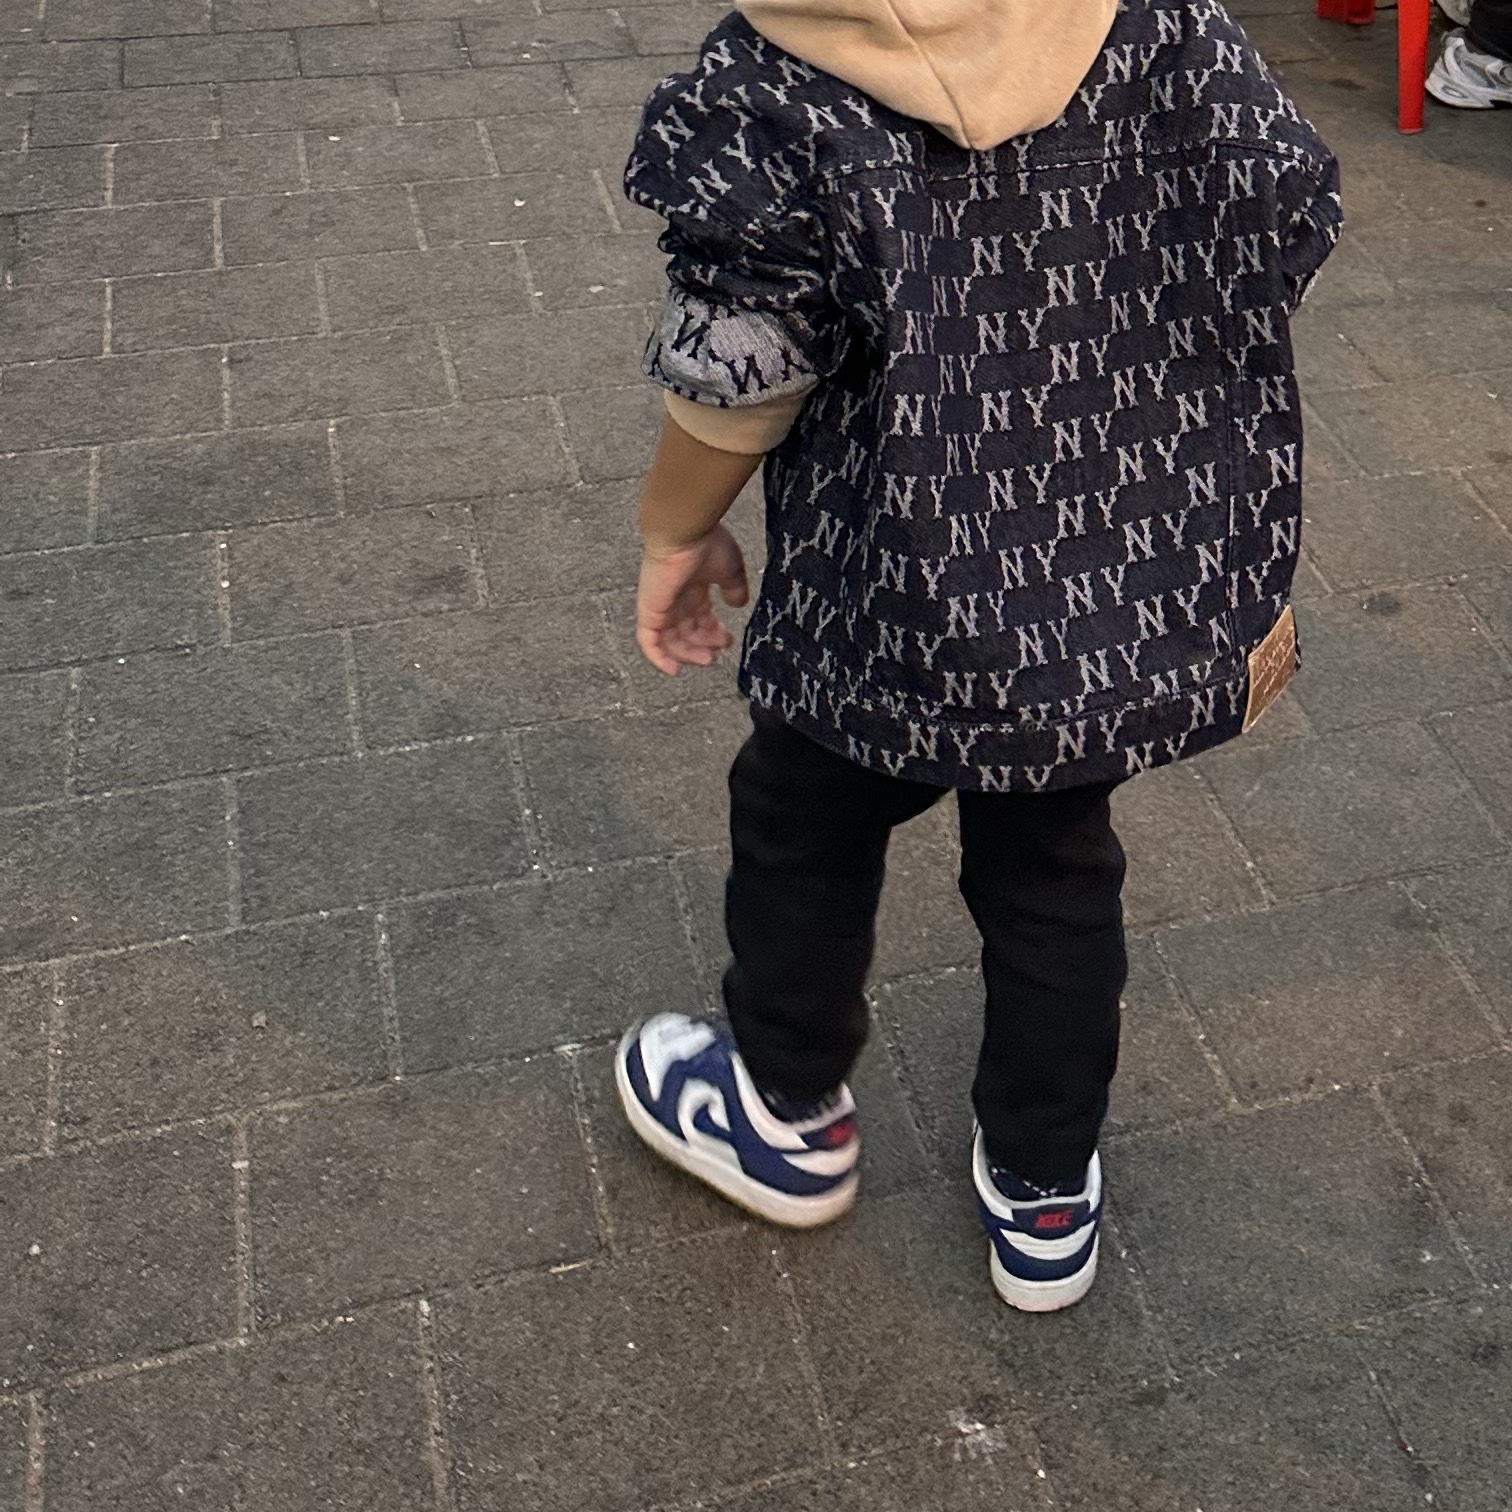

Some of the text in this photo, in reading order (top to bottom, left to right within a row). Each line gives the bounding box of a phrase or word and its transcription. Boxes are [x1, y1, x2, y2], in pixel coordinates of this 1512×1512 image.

[1155, 4, 1212, 44] NY
[703, 36, 768, 76] NY
[1103, 43, 1160, 84] NY
[1150, 68, 1210, 113] NY
[803, 96, 876, 134] NY
[1210, 102, 1278, 140] NY
[1039, 184, 1104, 231] NY
[1153, 164, 1208, 211] NY
[931, 197, 969, 239] NY
[1105, 209, 1157, 259] NY
[971, 230, 1041, 277] NY
[1160, 239, 1216, 285] NY
[932, 275, 973, 317] NY
[1044, 259, 1107, 307] NY
[976, 307, 1047, 355] NY
[1109, 284, 1163, 334] NY
[939, 353, 979, 396] NY
[1050, 335, 1111, 384] NY
[1113, 357, 1171, 411] NY
[890, 392, 942, 437] NY
[980, 384, 1052, 433] NY
[945, 431, 983, 476] NY
[1052, 410, 1114, 465] NY
[1116, 433, 1181, 486] NY
[883, 472, 948, 520] NY
[986, 462, 1053, 512] NY
[950, 510, 992, 557] NY
[1056, 486, 1119, 539] NY
[1123, 509, 1189, 563] NY
[879, 548, 948, 601] NY
[998, 539, 1058, 590] NY
[947, 590, 1005, 639] NY
[1061, 563, 1127, 618] NY
[1134, 584, 1201, 641] NY
[877, 620, 944, 671] NY
[1015, 616, 1069, 670] NY
[1077, 639, 1142, 695] NY
[943, 668, 1017, 710] NY
[1190, 676, 1246, 731] NY
[907, 719, 980, 767] NY
[1056, 708, 1127, 766] NY
